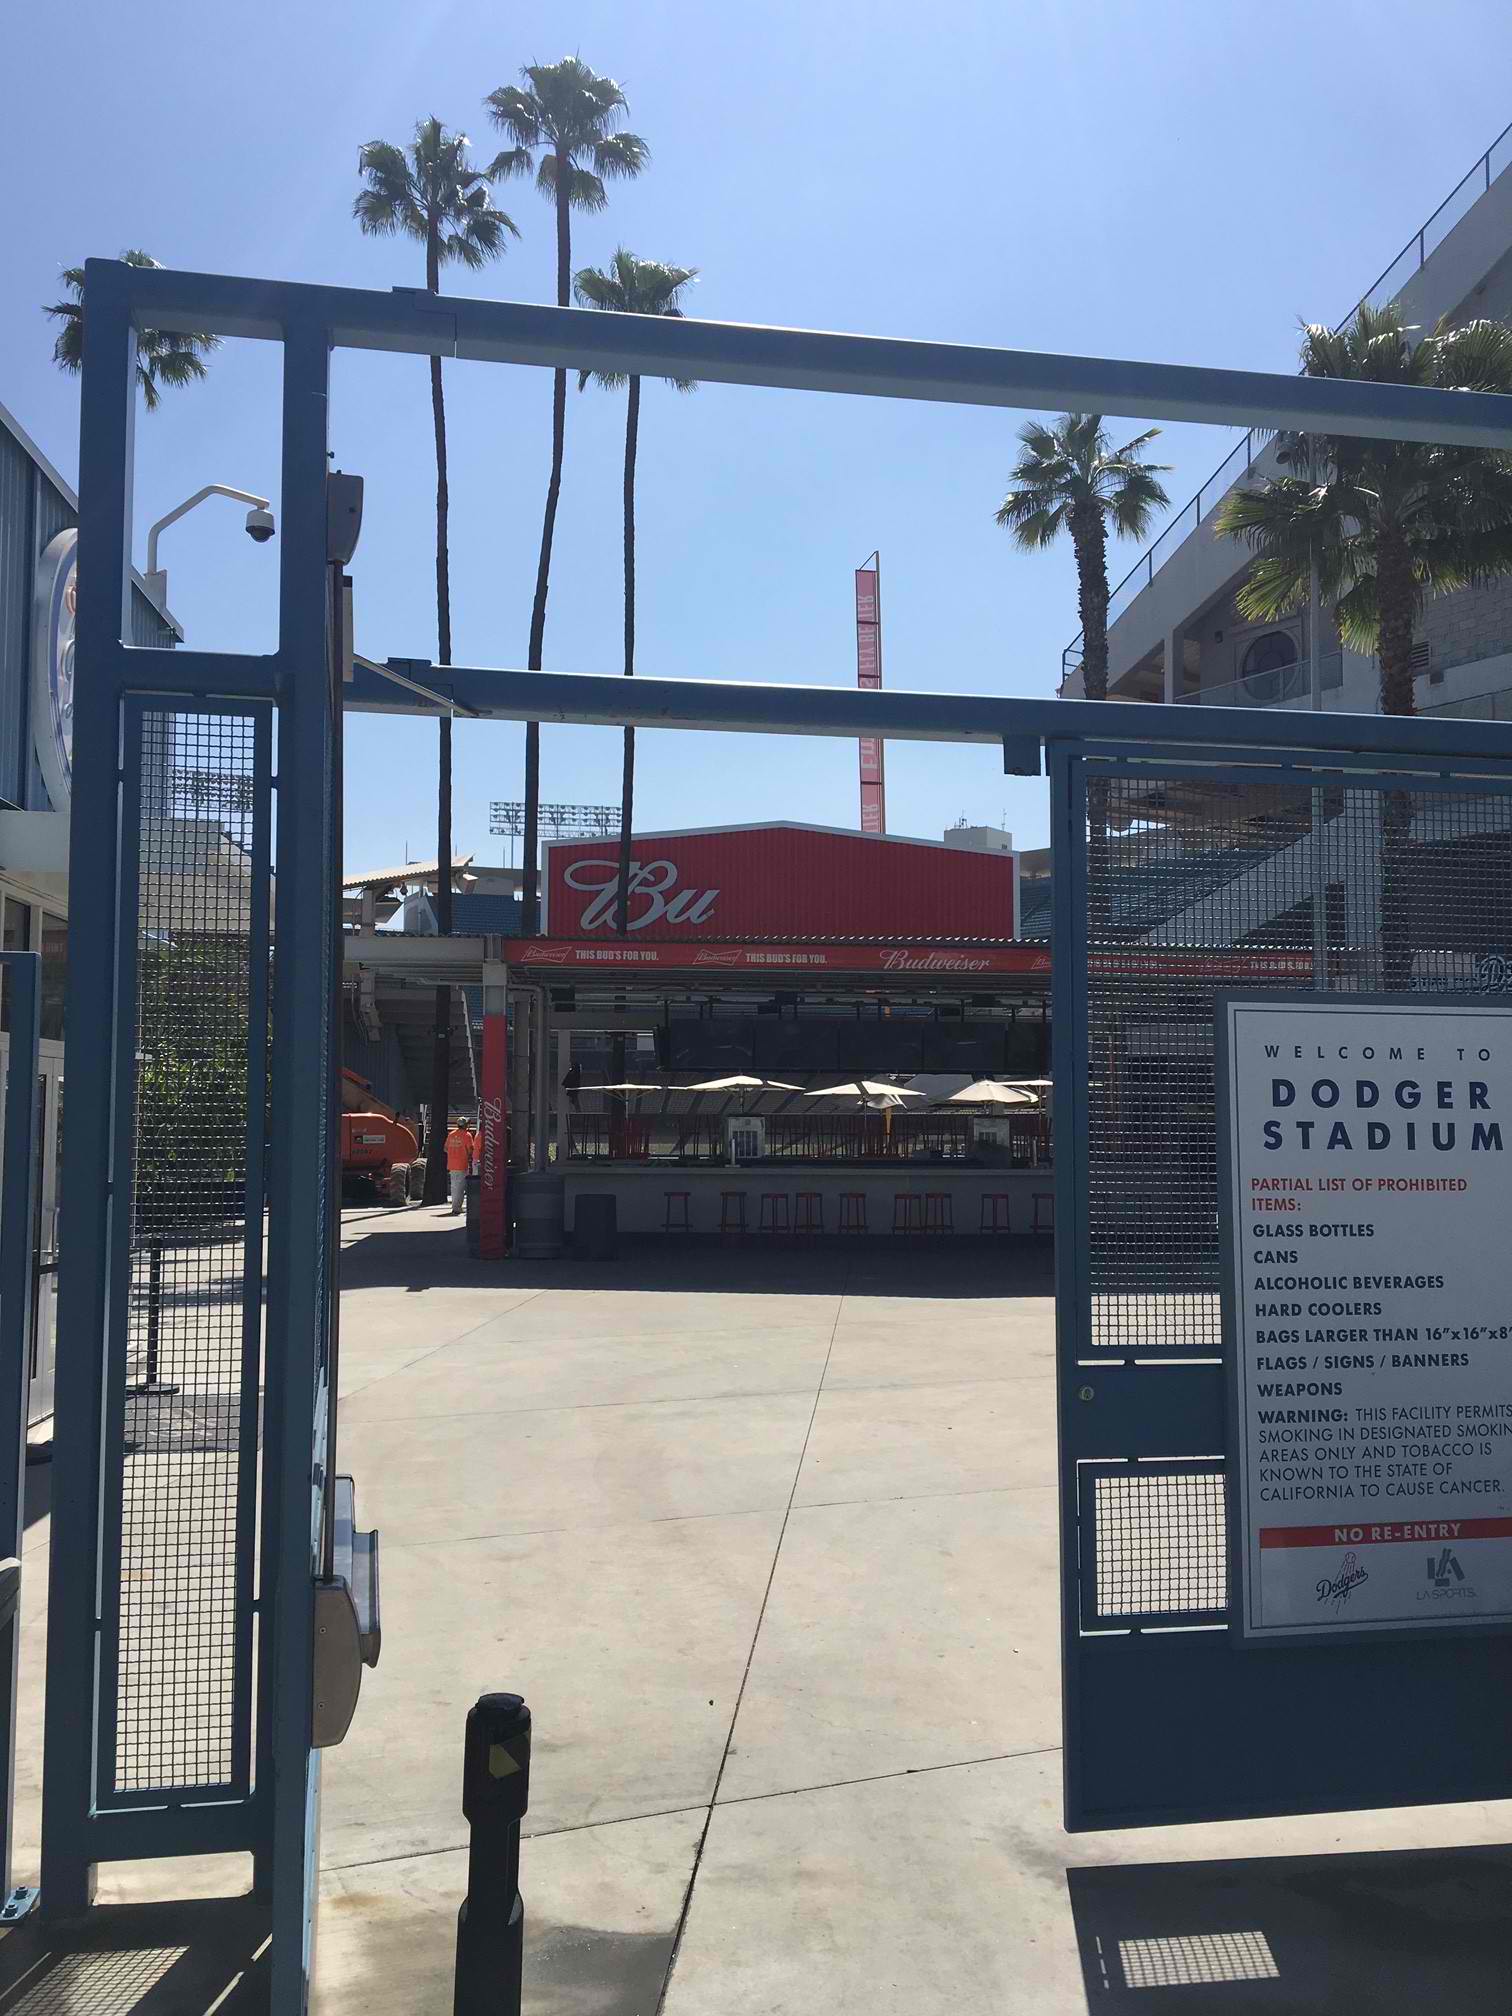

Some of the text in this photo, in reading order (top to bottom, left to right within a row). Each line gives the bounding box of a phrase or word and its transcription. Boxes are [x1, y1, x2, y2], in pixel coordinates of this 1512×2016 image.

[576, 950, 595, 960] THIS
[596, 950, 621, 960] BUD'S
[623, 951, 639, 960] FOR
[745, 953, 765, 962] THIS
[766, 953, 791, 963] BUD'S
[792, 954, 808, 963] FOR
[880, 950, 990, 971] Budweiser
[1264, 1045, 1490, 1061] WELCOME TO
[1272, 1079, 1491, 1110] DODGER
[1263, 1120, 1504, 1151] STADIUM
[1251, 1178, 1467, 1192] PARTIAL LIST OF PROHIBITED
[1252, 1198, 1302, 1211] ITEMS:
[1253, 1224, 1374, 1237] GLASS BOTTLES
[1253, 1251, 1298, 1264] CANS
[1254, 1276, 1444, 1290] ALCOHOLIC BEVERAGES
[1255, 1302, 1382, 1317] HARD COOLERS
[1256, 1330, 1300, 1343] BAGS
[1305, 1329, 1368, 1343] LARGER
[1373, 1328, 1418, 1341] THAN
[1257, 1353, 1469, 1370] FLAGS / SIGNS / BANNERS
[1257, 1382, 1343, 1397] WEAPONS
[1258, 1404, 1512, 1424] WARNING: THIS FACILITY PERMITS
[1258, 1423, 1512, 1443] SMOKING IN DESIGNATED SMOKIN
[1259, 1442, 1492, 1462] AREAS ONLY AND TOBACCO IS
[1260, 1462, 1452, 1481] KNOWN TO THE STATE OF
[1260, 1480, 1505, 1501] CALIFORNIA TO CAUSE CANCER.
[1334, 1523, 1462, 1542] NO RE-ENTRY
[1316, 1566, 1369, 1601] Dodgers
